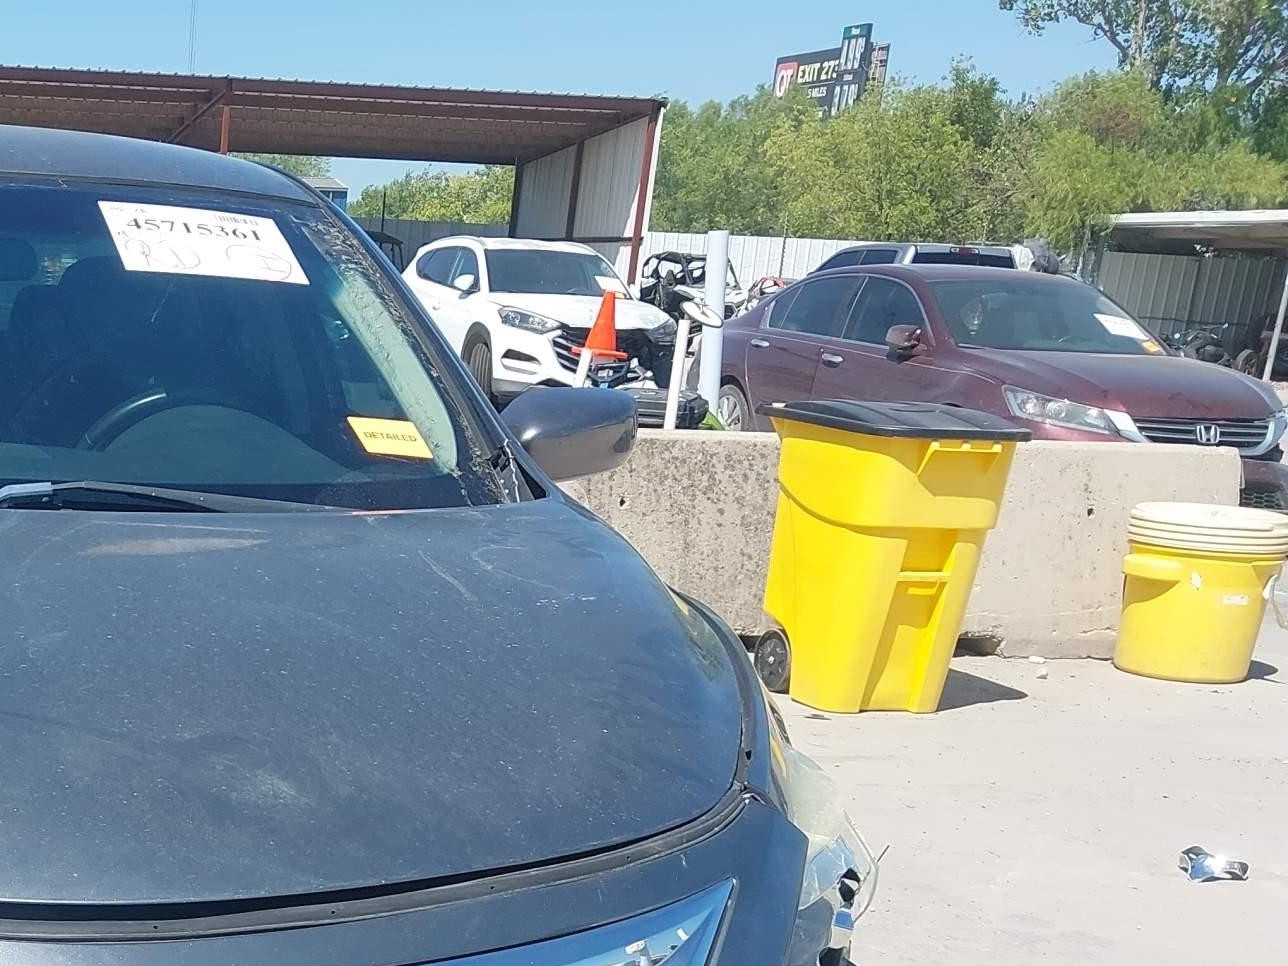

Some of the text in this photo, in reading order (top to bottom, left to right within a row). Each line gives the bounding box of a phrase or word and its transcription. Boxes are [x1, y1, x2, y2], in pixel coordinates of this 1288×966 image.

[797, 60, 822, 83] EXIT
[127, 218, 262, 242] 45715361
[363, 428, 418, 444] DETAILED
